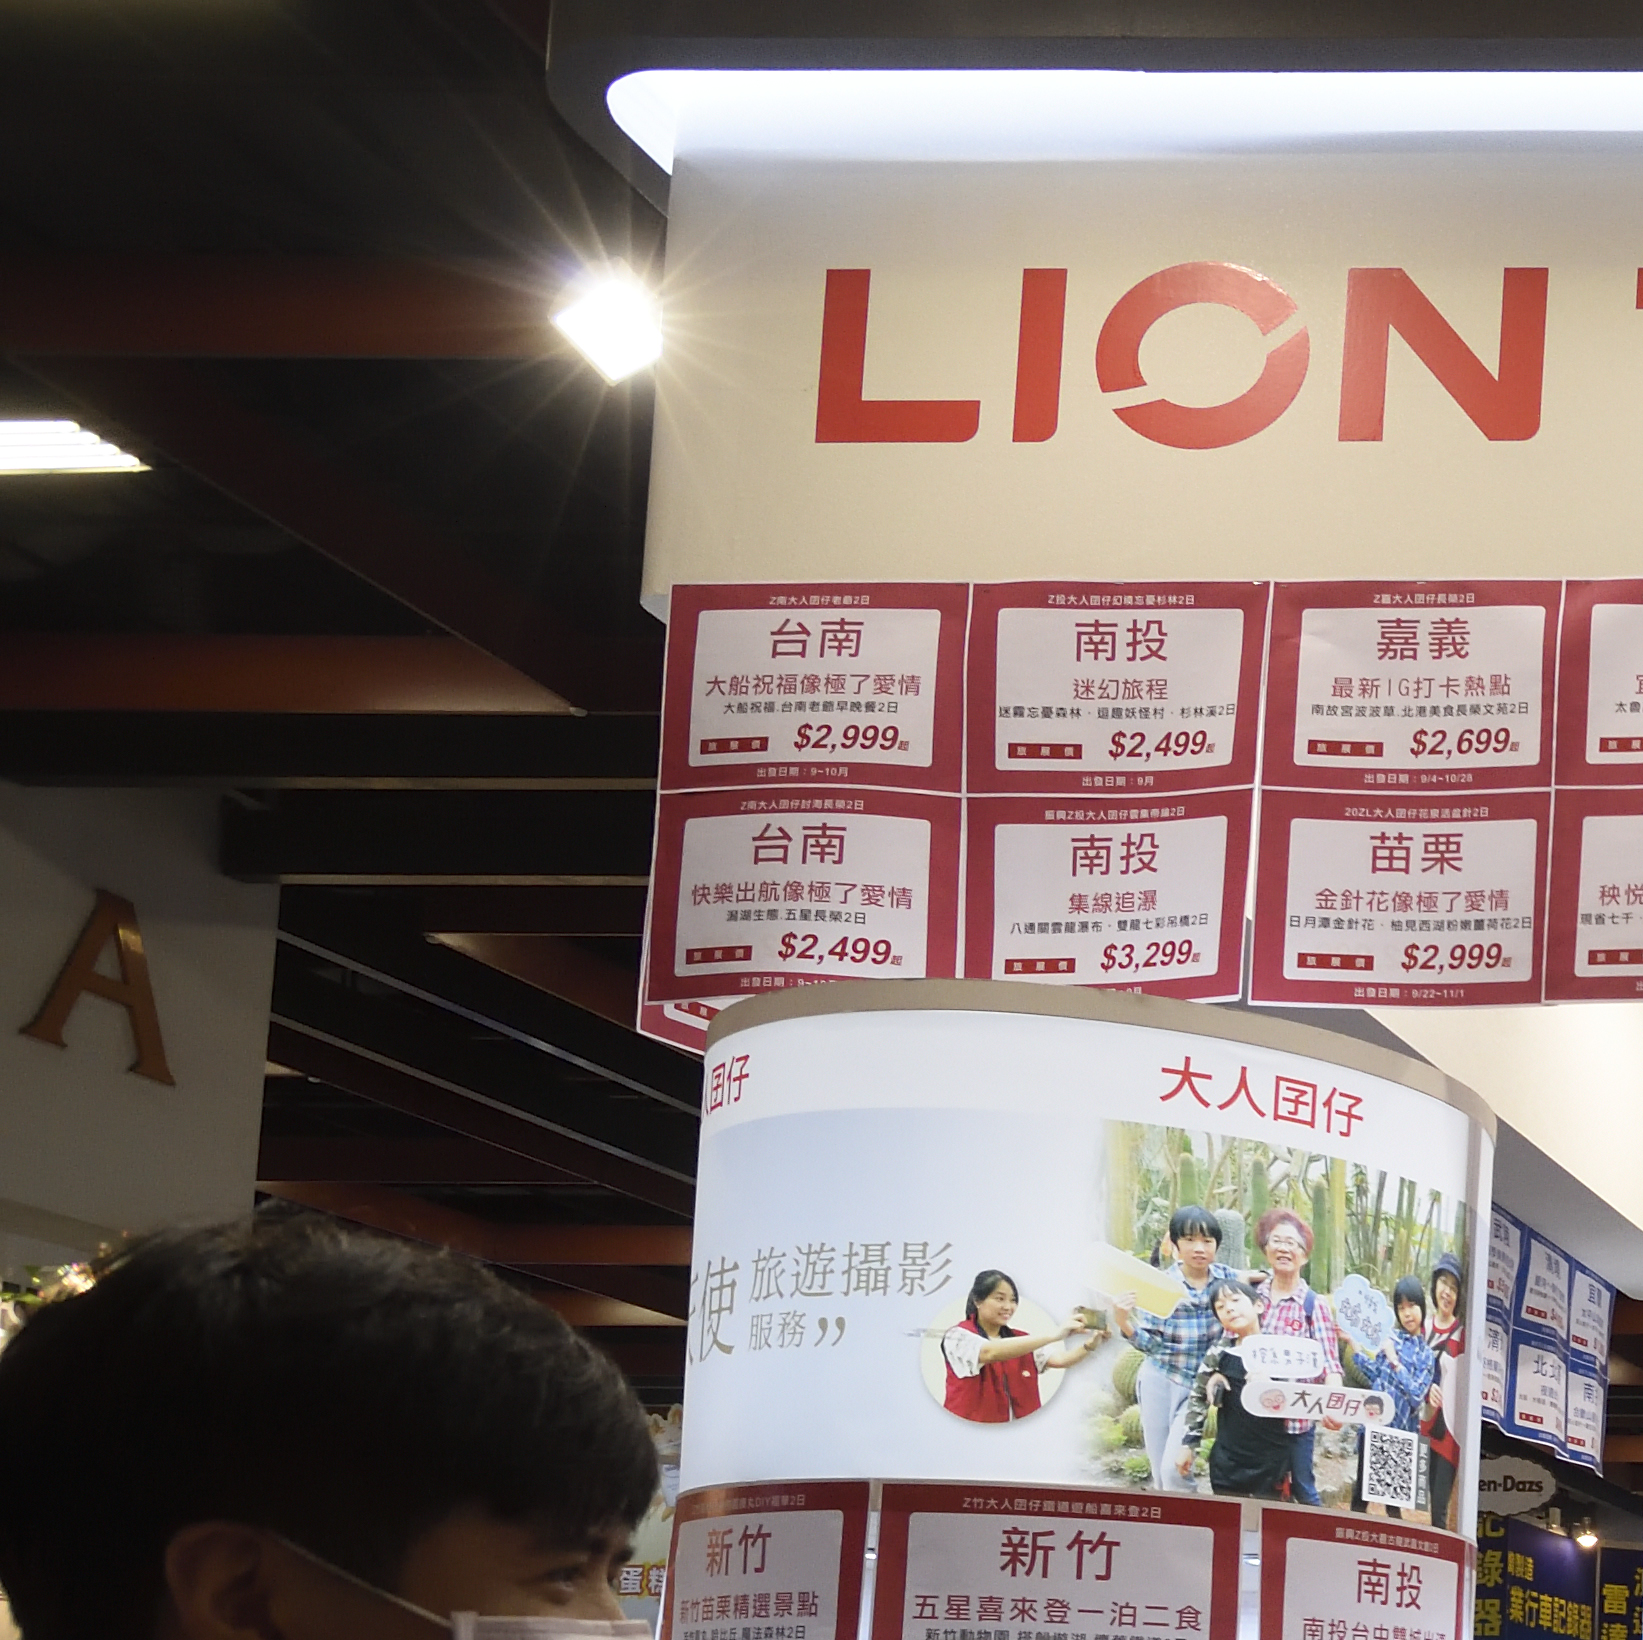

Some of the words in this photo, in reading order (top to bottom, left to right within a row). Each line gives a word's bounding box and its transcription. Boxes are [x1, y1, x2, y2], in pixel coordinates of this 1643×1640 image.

[815, 263, 1549, 449] LION
[770, 618, 864, 658] 台南
[1075, 619, 1167, 662] 南投
[1377, 618, 1470, 660] 嘉義
[705, 674, 921, 697] 大船祝福像極了愛情
[1073, 679, 1168, 700] 迷幻旅程
[1332, 674, 1511, 699] 最新IG打卡熱點
[752, 823, 846, 865] 台南
[1071, 833, 1159, 877] 南投
[1370, 832, 1463, 874] 苗栗
[691, 881, 912, 911] 快樂出航像極了愛情
[1069, 890, 1157, 914] 集線追瀑
[1315, 888, 1509, 913] 金針花像極了愛情
[1160, 1055, 1366, 1137] 大人囝仔
[749, 1241, 952, 1302] 旅遊攝影
[706, 1524, 772, 1577] 新竹
[1000, 1527, 1120, 1580] 新竹
[1357, 1558, 1422, 1610] 南投
[681, 1591, 819, 1622] 新竹苗栗精選景點
[912, 1595, 1201, 1631] 五星喜來登一泊二食
